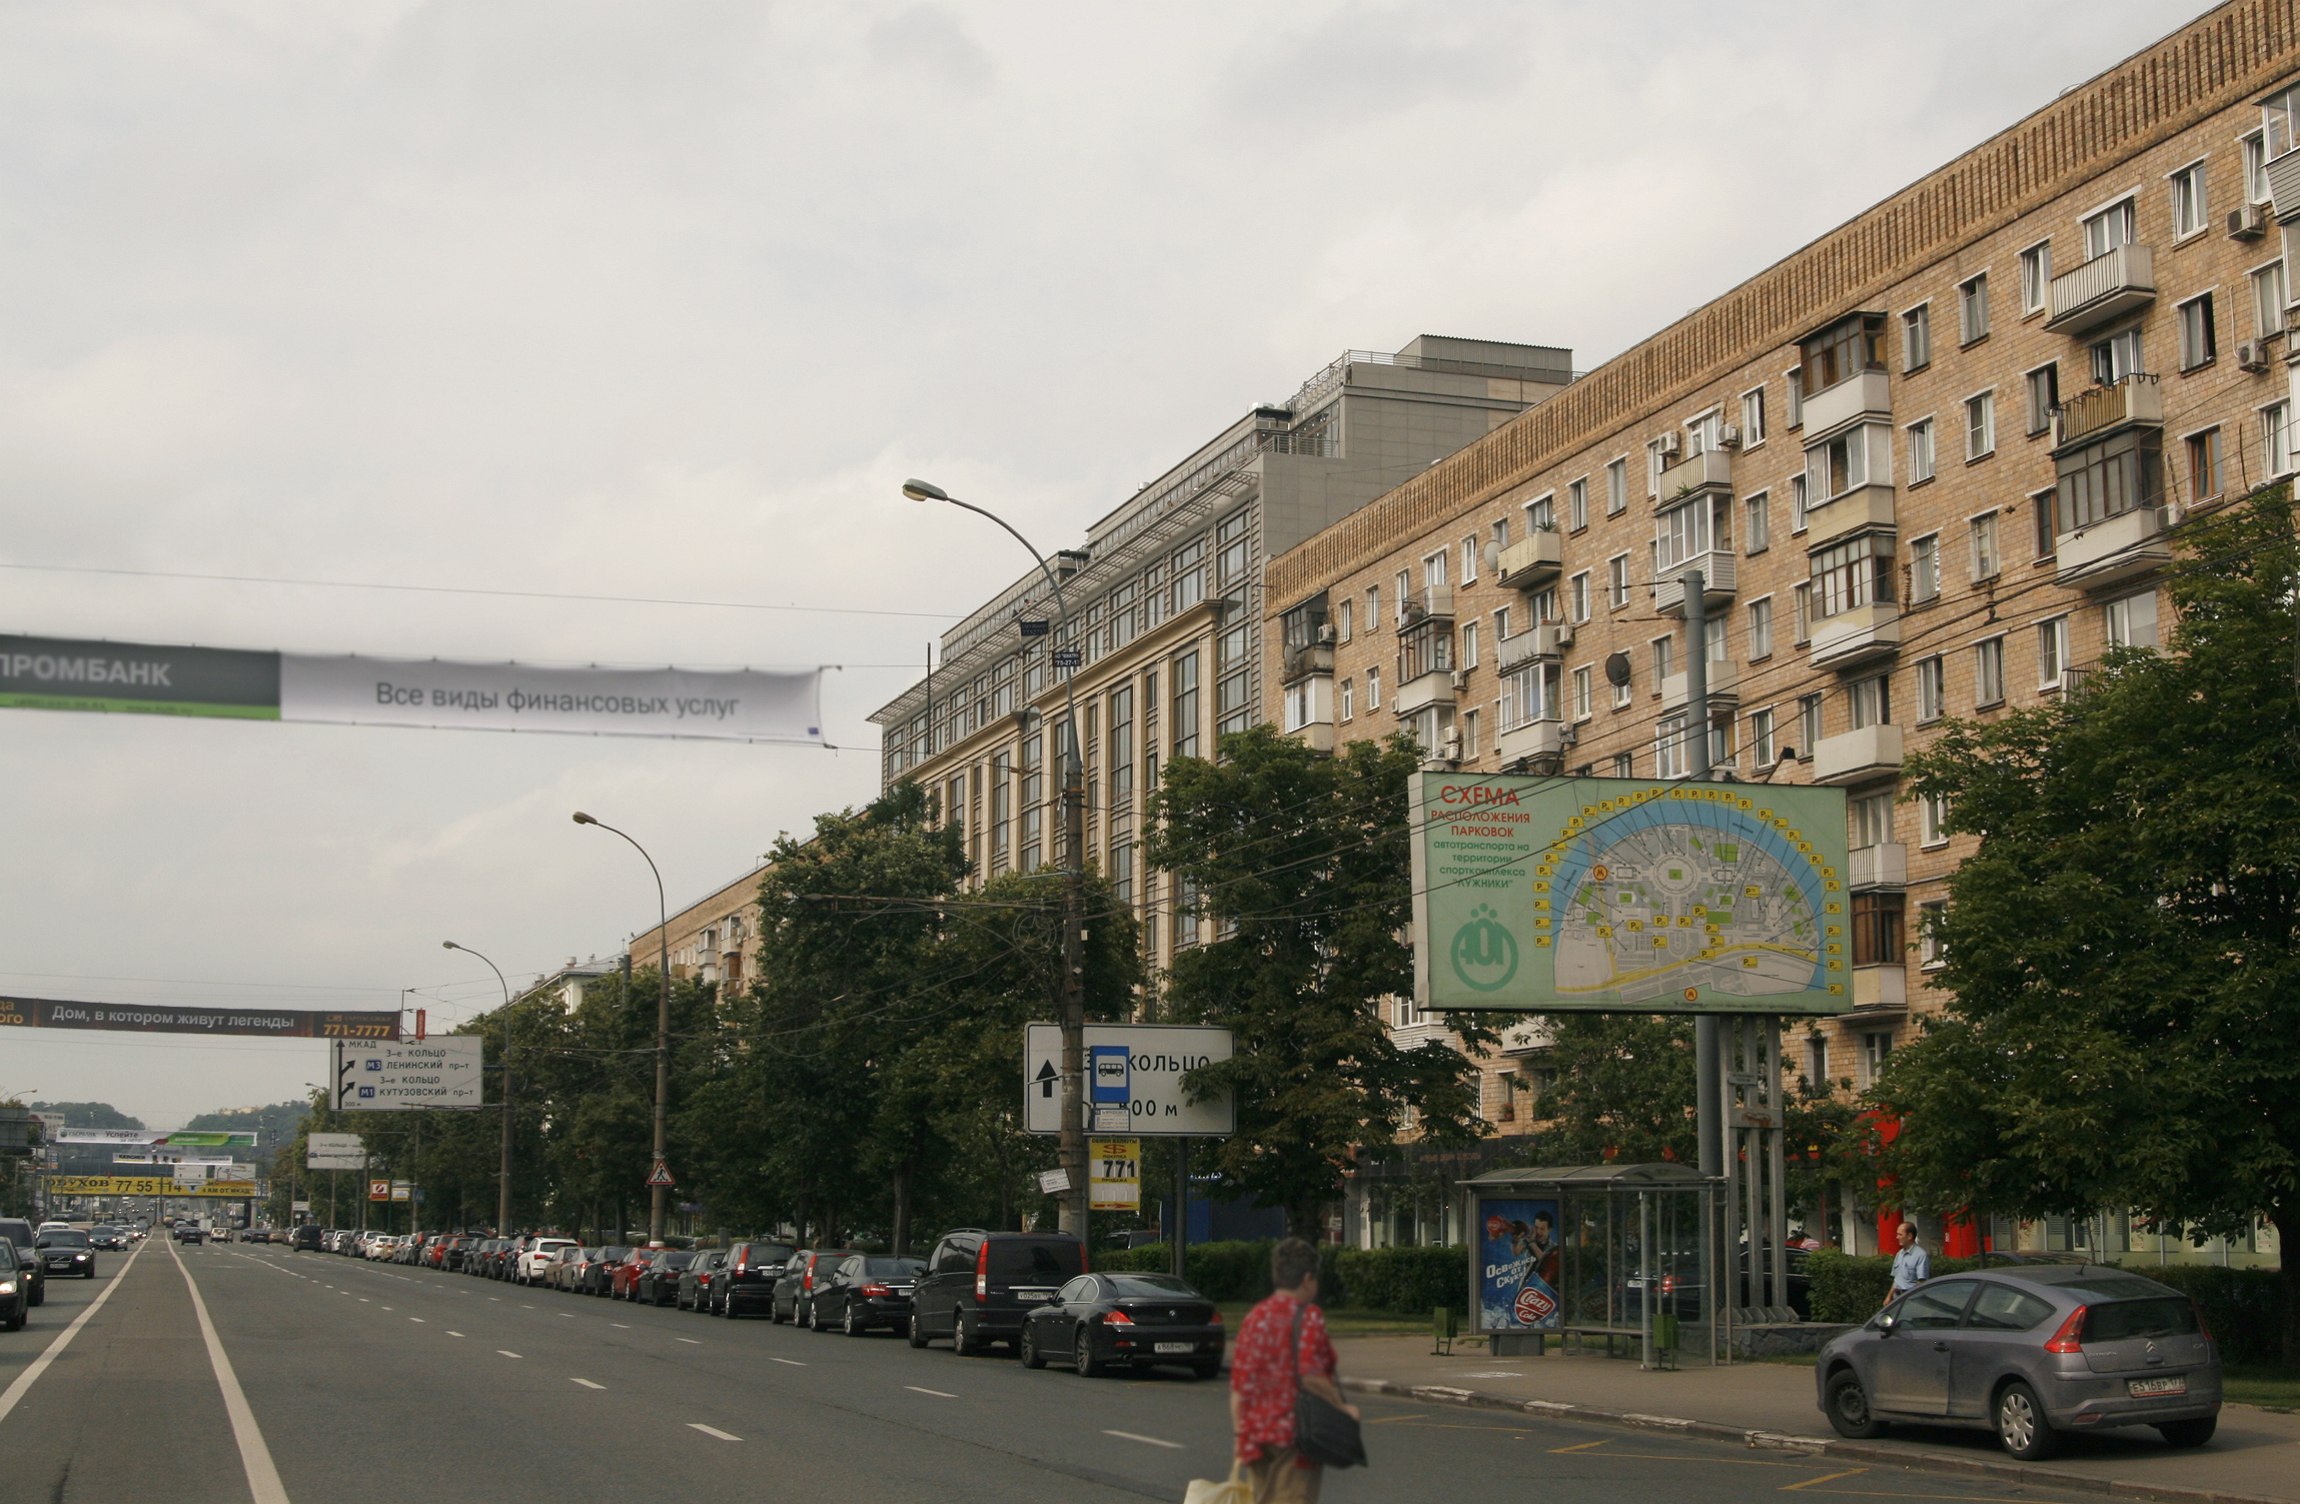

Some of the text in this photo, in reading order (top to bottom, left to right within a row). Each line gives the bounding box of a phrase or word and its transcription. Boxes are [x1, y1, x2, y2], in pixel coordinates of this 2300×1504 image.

[376, 683, 741, 720] Все виды финансовых услуг
[1440, 785, 1520, 806] СХЕМА
[1431, 810, 1531, 823] РАСПОЛОЖЕНИЯ
[1451, 825, 1515, 838] ПАРКОВОК
[1433, 840, 1530, 851] автотранспорта на
[1452, 854, 1513, 864] территории
[1439, 866, 1526, 878] спорткомплекса
[52, 1005, 295, 1029] Дом, в котором живут легенды
[323, 1023, 391, 1037] 771-7777
[349, 1040, 377, 1049] МКАД
[386, 1049, 447, 1058] 3-е КОЛЬЦО
[366, 1059, 469, 1070] М3 ЛЕНИНСКИЙ пр-т
[1129, 1054, 1210, 1072] КОЛЬЦО
[380, 1076, 441, 1085] 3-е КОЛЬЦО
[360, 1086, 474, 1097] М1 КУТУЗОВСКИЙ пр-т
[1165, 1104, 1178, 1117] м
[105, 1130, 138, 1139] Успейте
[1103, 1160, 1135, 1178] 771
[116, 1181, 132, 1192] 77
[136, 1181, 153, 1192] 55
[1519, 1290, 1551, 1312] Crazy
